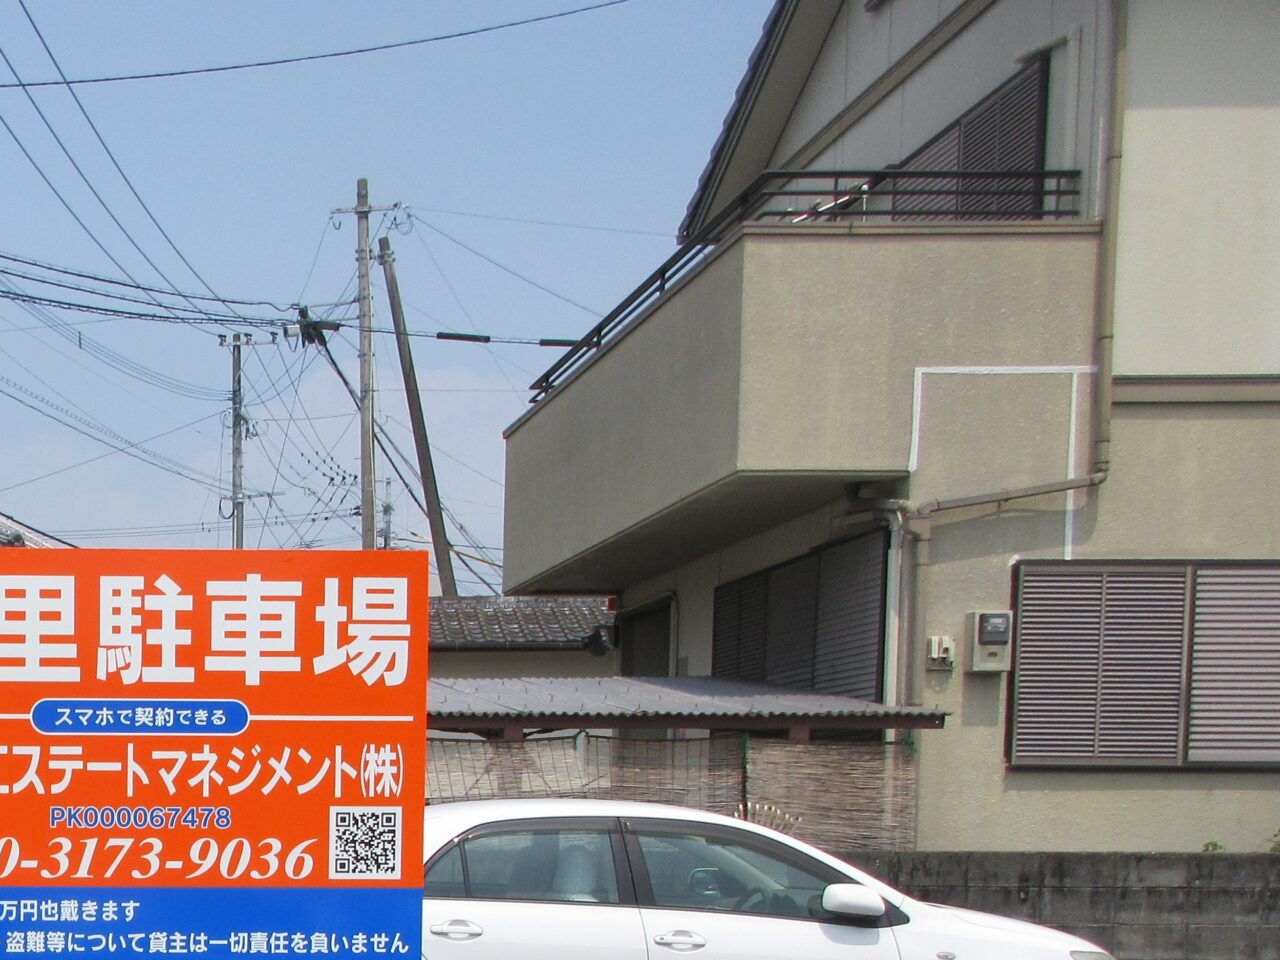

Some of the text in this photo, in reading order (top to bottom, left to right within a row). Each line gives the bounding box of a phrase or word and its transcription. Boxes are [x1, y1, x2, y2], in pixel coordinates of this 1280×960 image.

[55, 707, 227, 727] スマホで契約できる
[49, 806, 232, 829] PK000067478
